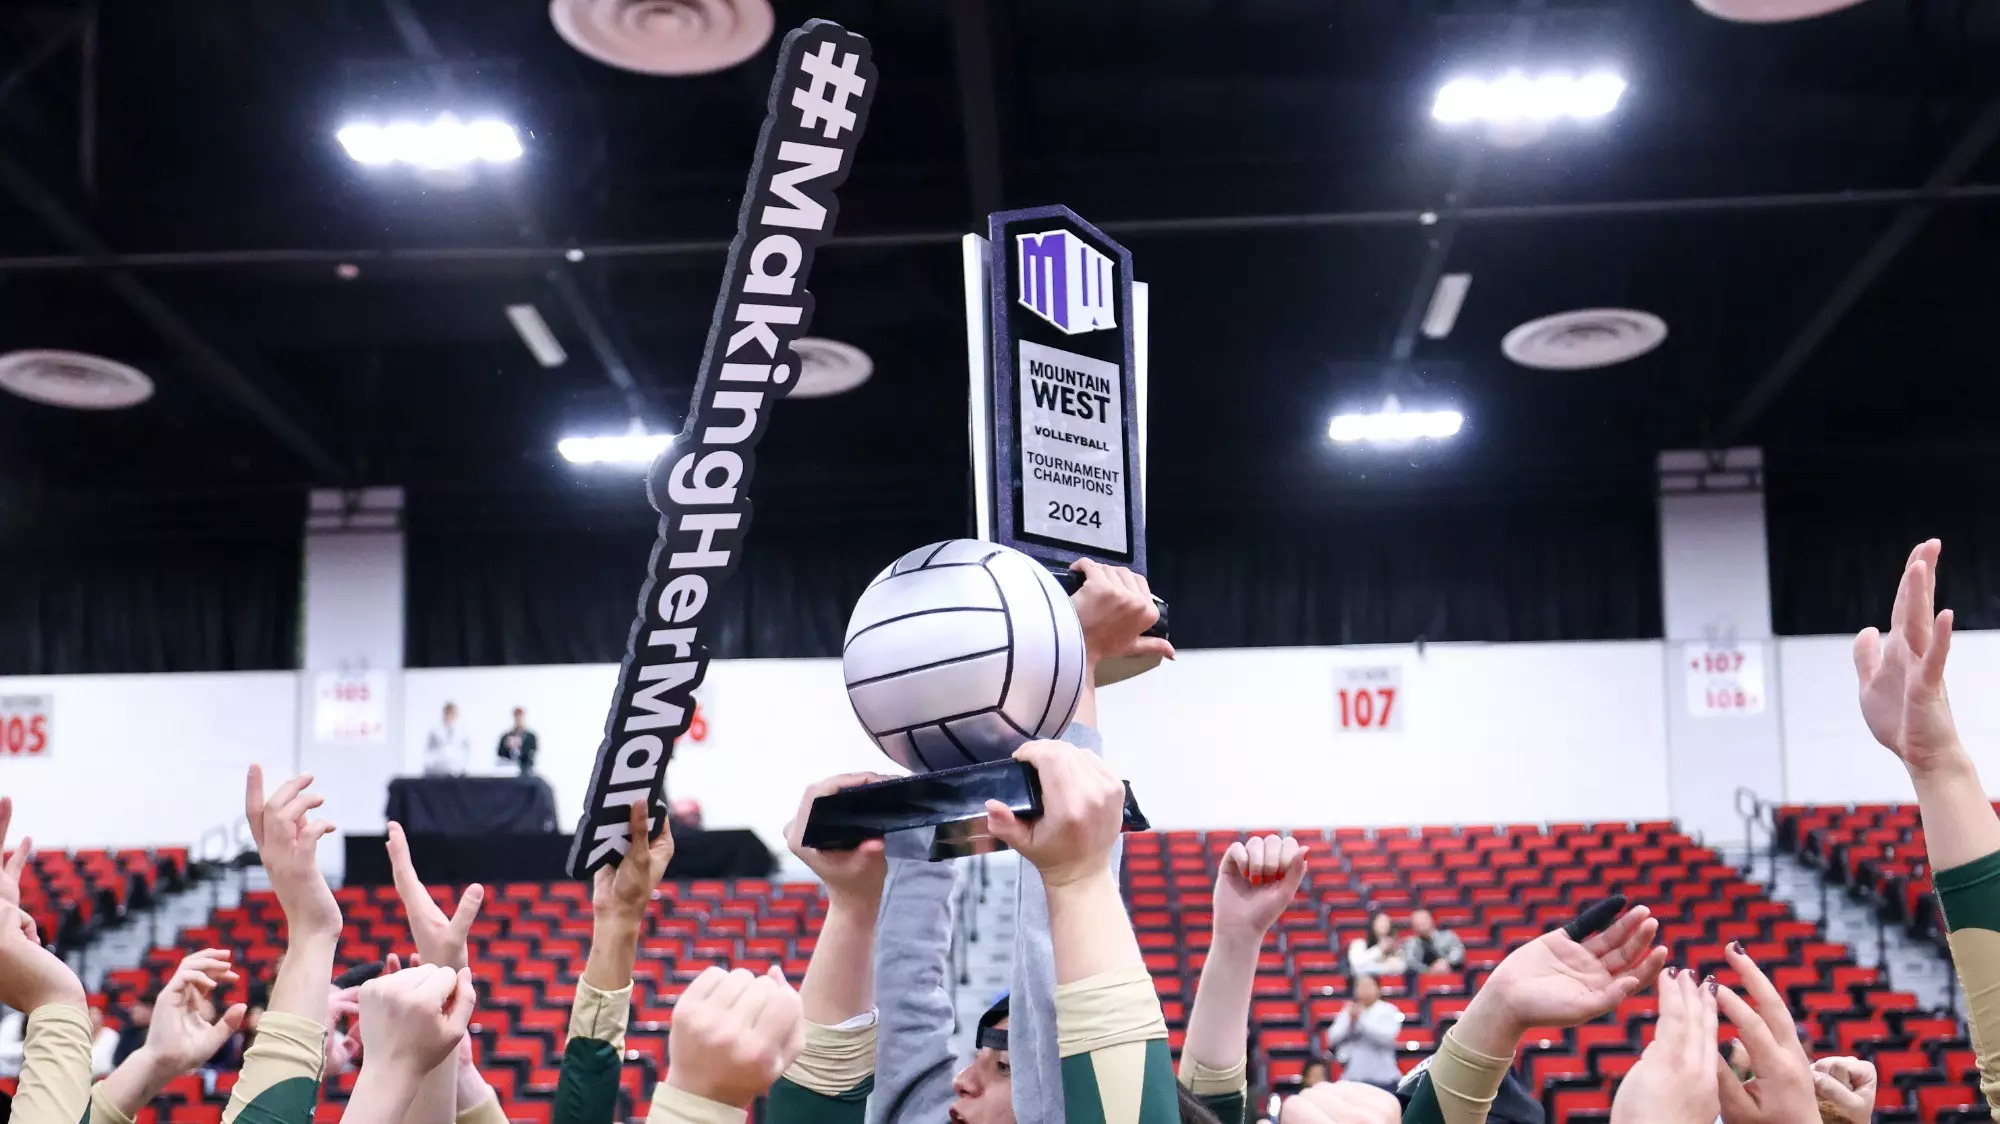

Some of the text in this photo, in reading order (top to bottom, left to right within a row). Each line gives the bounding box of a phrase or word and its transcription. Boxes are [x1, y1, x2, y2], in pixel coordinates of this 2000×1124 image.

[1030, 359, 1110, 395] MOUNTAIN
[1031, 378, 1110, 424] WEST
[1035, 425, 1110, 452] VOLLEYBALL
[586, 41, 866, 869] #MakingHerMark
[1027, 451, 1119, 483] TOURNAMENT
[1033, 467, 1113, 496] CHAMPIONS
[1048, 501, 1102, 529] 2024
[1704, 652, 1745, 673] 107
[1336, 687, 1396, 728] 107
